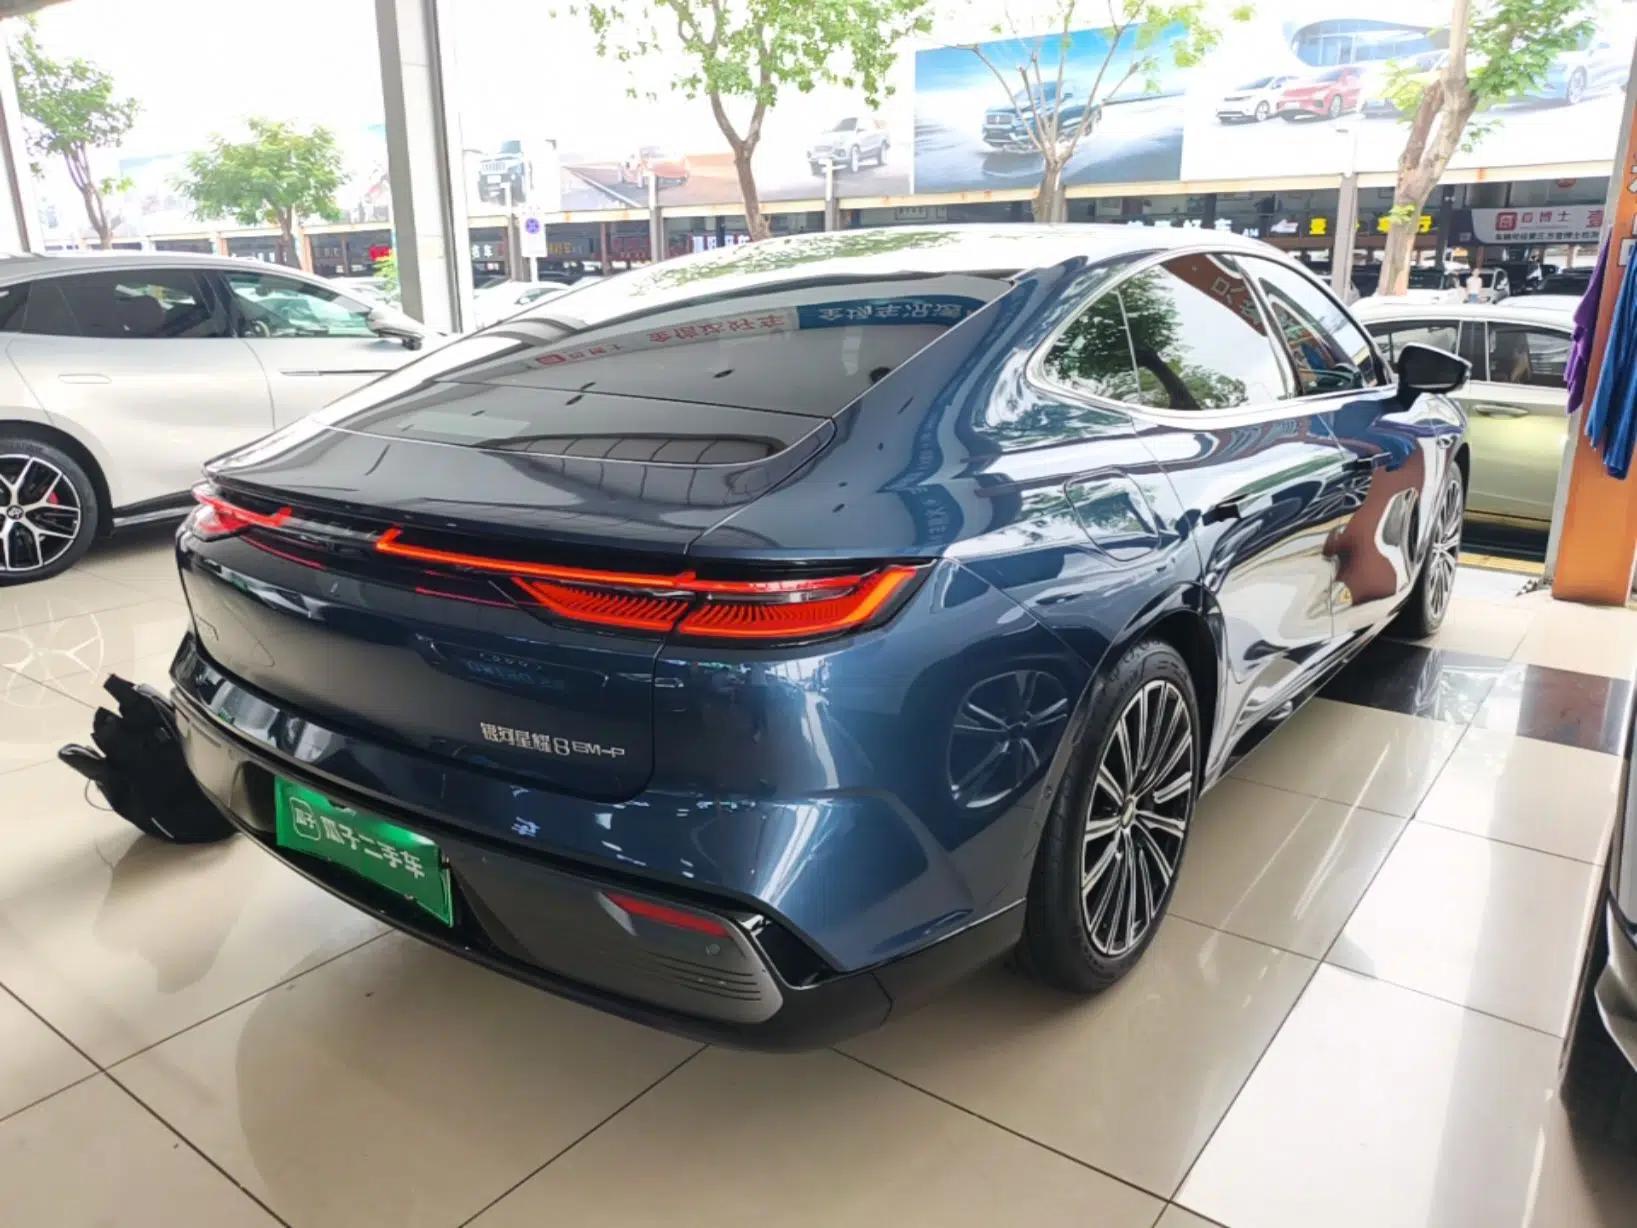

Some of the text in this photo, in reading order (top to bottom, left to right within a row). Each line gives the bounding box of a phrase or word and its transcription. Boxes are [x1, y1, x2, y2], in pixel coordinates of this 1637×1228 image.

[571, 741, 625, 758] EM-P
[320, 815, 425, 879] 瓜子二手车
